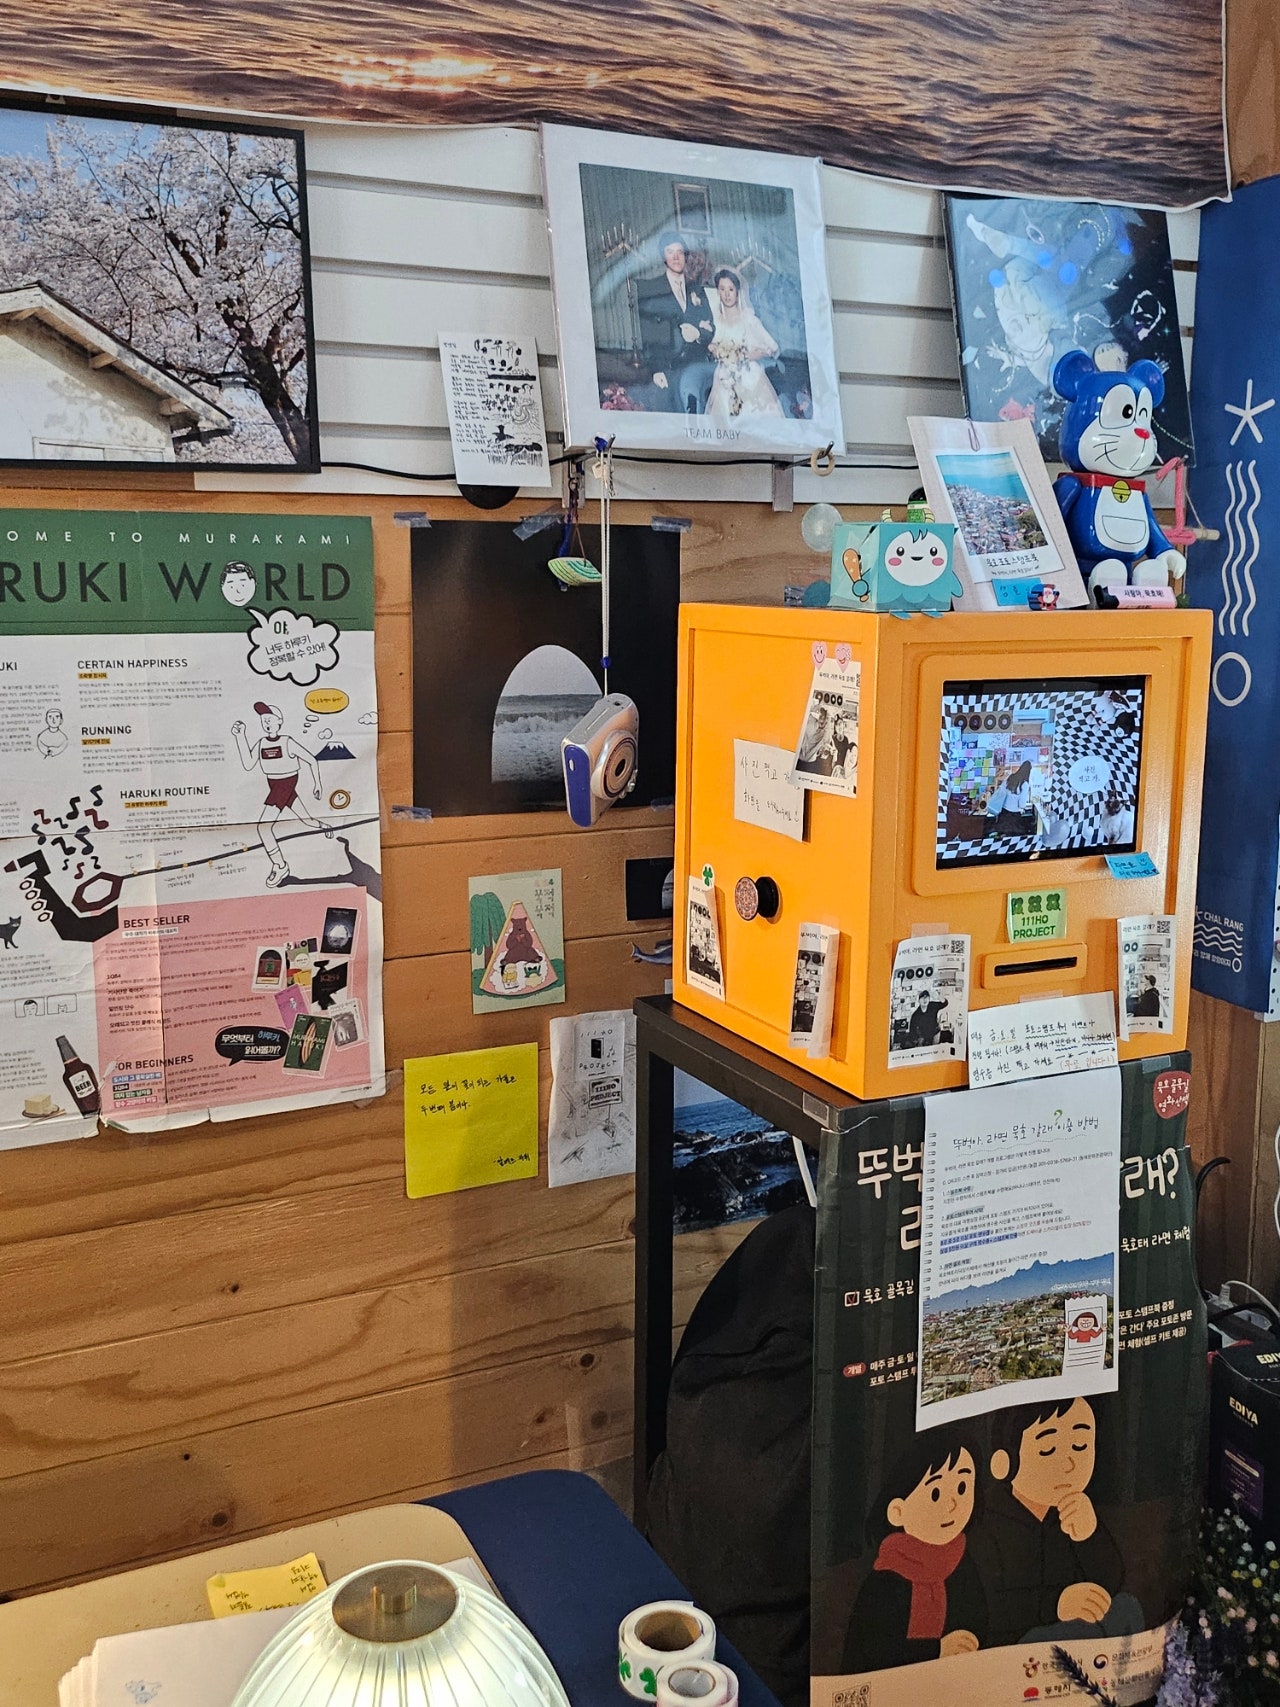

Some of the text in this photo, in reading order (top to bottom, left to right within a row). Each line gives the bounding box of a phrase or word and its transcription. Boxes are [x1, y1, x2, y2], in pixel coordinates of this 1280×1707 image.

[685, 428, 741, 441] TEAM BABY
[109, 531, 143, 544] TO
[179, 532, 350, 545] MURAKAMI
[285, 634, 311, 650] 하루키
[296, 648, 306, 658] 수
[77, 658, 188, 669] CERTAIN HAPPINESS
[81, 725, 132, 736] RUNNING
[120, 786, 210, 799] HARUKI ROUTINE
[123, 914, 190, 929] BEST SELLER
[1204, 911, 1244, 932] CHAL RANG
[1013, 925, 1056, 938] PROJECT
[222, 1034, 254, 1043] 무엇부터
[136, 1054, 194, 1070] BEGINNERS
[579, 1059, 617, 1070] PROJECT
[75, 1081, 92, 1092] BEER
[420, 1083, 437, 1095] 모든
[476, 1077, 492, 1088] 되는
[1157, 1078, 1190, 1093] 묵호 골목길
[987, 1130, 1008, 1145] 라면
[1012, 1123, 1027, 1141] 묵호
[1058, 1118, 1074, 1133] 이용
[1077, 1116, 1099, 1131] 방법
[1120, 1148, 1180, 1199] 래?
[1120, 1236, 1149, 1253] 묵호태
[1151, 1231, 1171, 1247] 라면
[863, 1279, 915, 1304] 묵호 골목길
[1119, 1309, 1133, 1320] 포토
[1162, 1299, 1175, 1311] 증정
[1146, 1319, 1160, 1330] 주요
[1161, 1313, 1179, 1326] 포토존
[1158, 1330, 1171, 1342] 키트
[870, 1360, 886, 1371] 매주
[869, 1375, 885, 1387] 포토
[887, 1368, 909, 1383] 스탬프
[1229, 1396, 1258, 1425] EDIYA
[1044, 1683, 1071, 1695] 동해시
